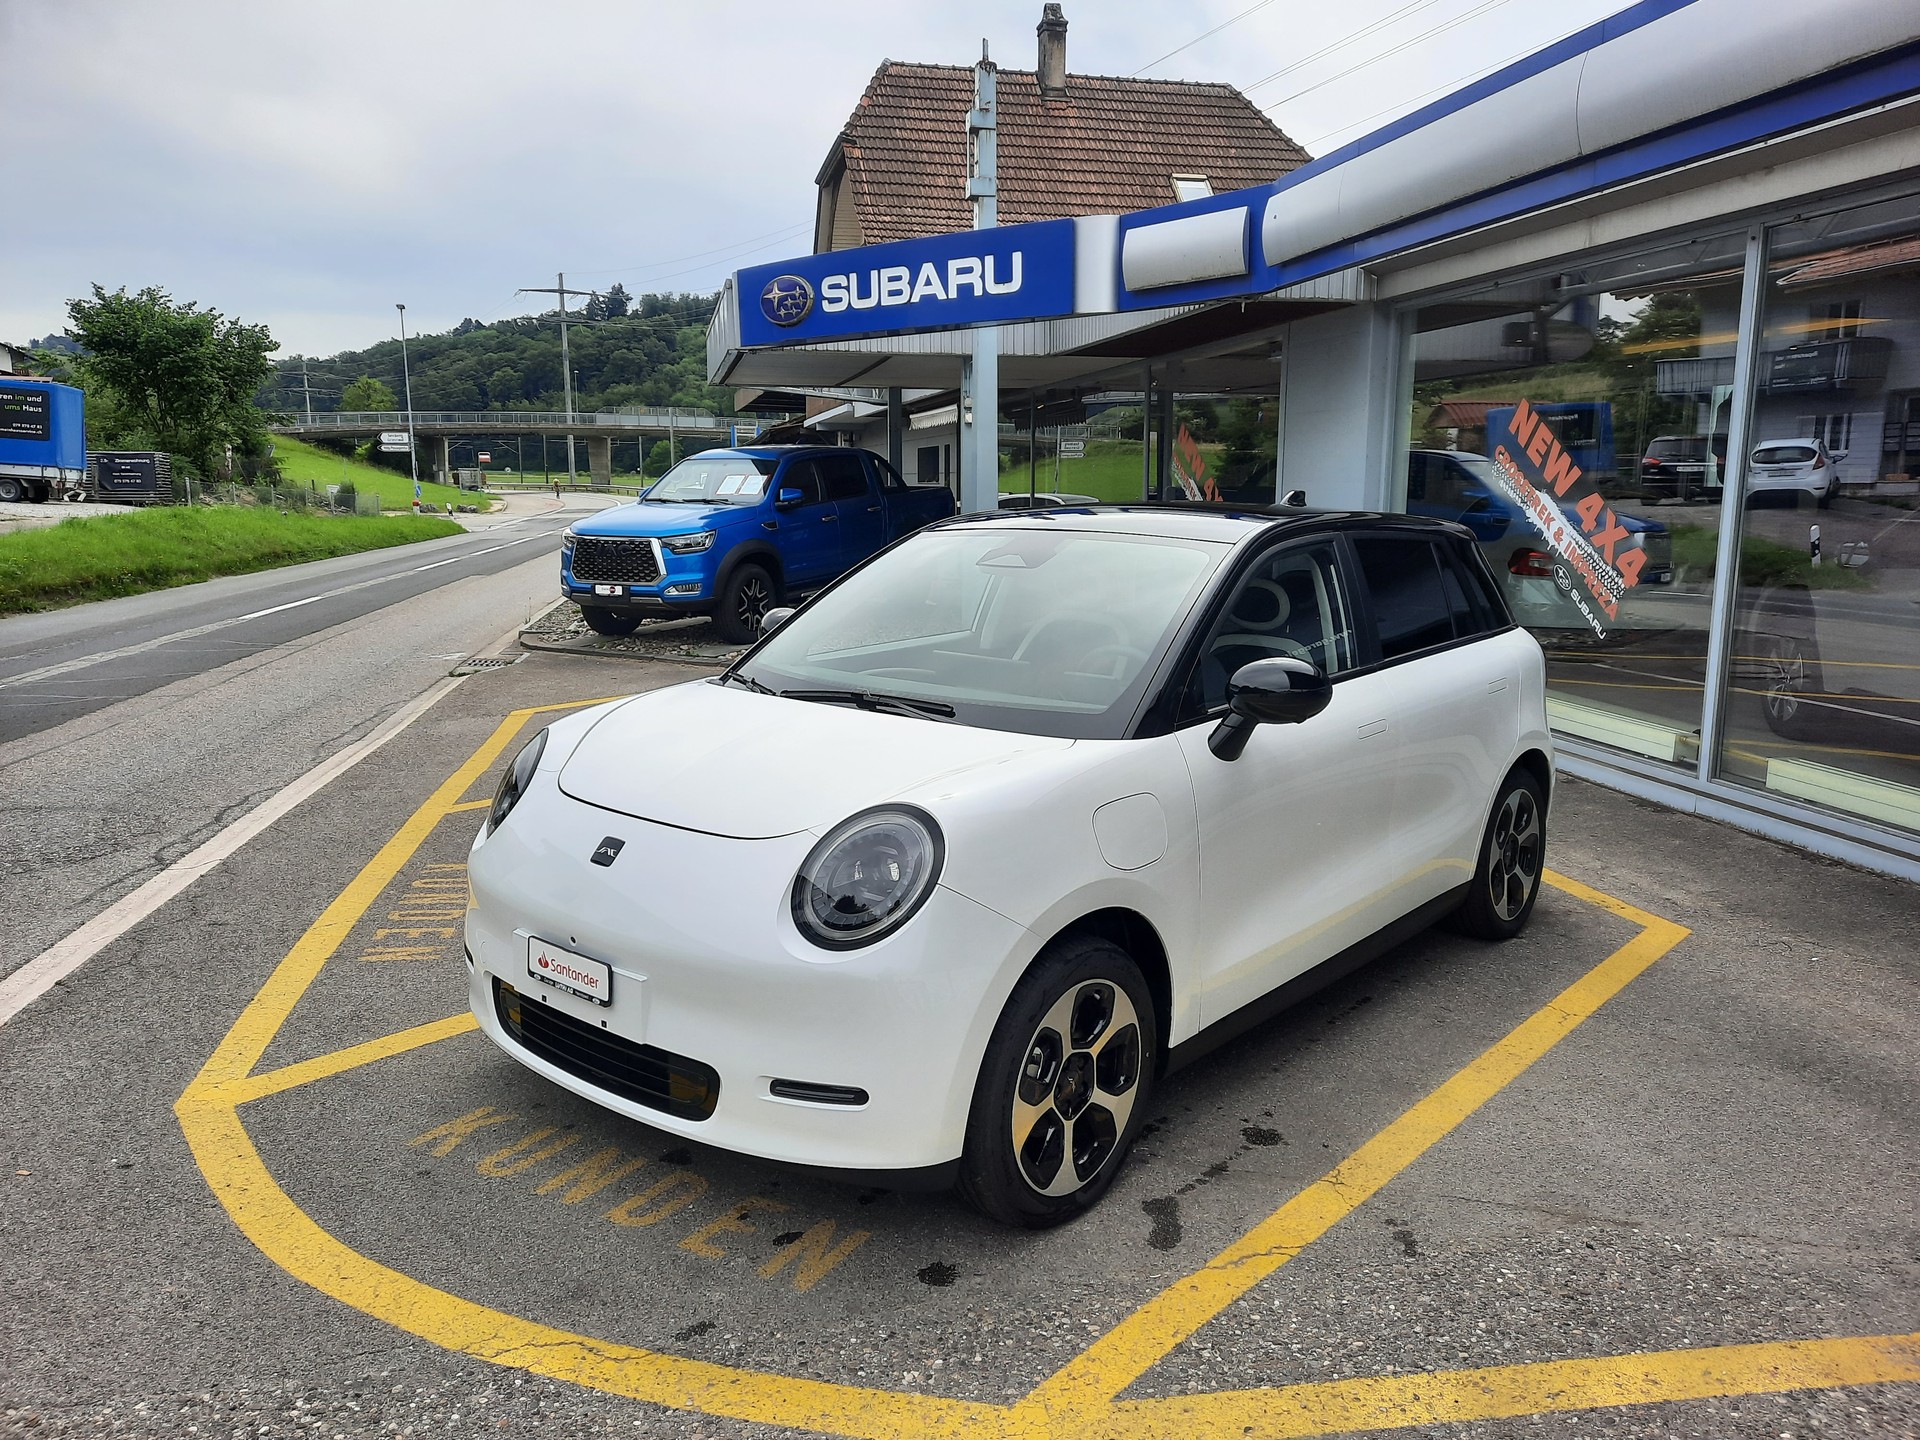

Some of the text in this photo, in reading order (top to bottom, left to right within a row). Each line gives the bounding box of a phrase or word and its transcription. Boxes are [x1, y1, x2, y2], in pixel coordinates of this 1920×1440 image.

[821, 251, 1022, 313] SUBARU
[22, 404, 43, 413] Haus
[1508, 398, 1648, 589] NEW 4X4
[1553, 526, 1565, 547] &
[1563, 540, 1620, 622] IMPREZA
[1571, 588, 1607, 640] SUBARU
[550, 958, 600, 990] Santander
[407, 1105, 872, 1293] KUNDEN
